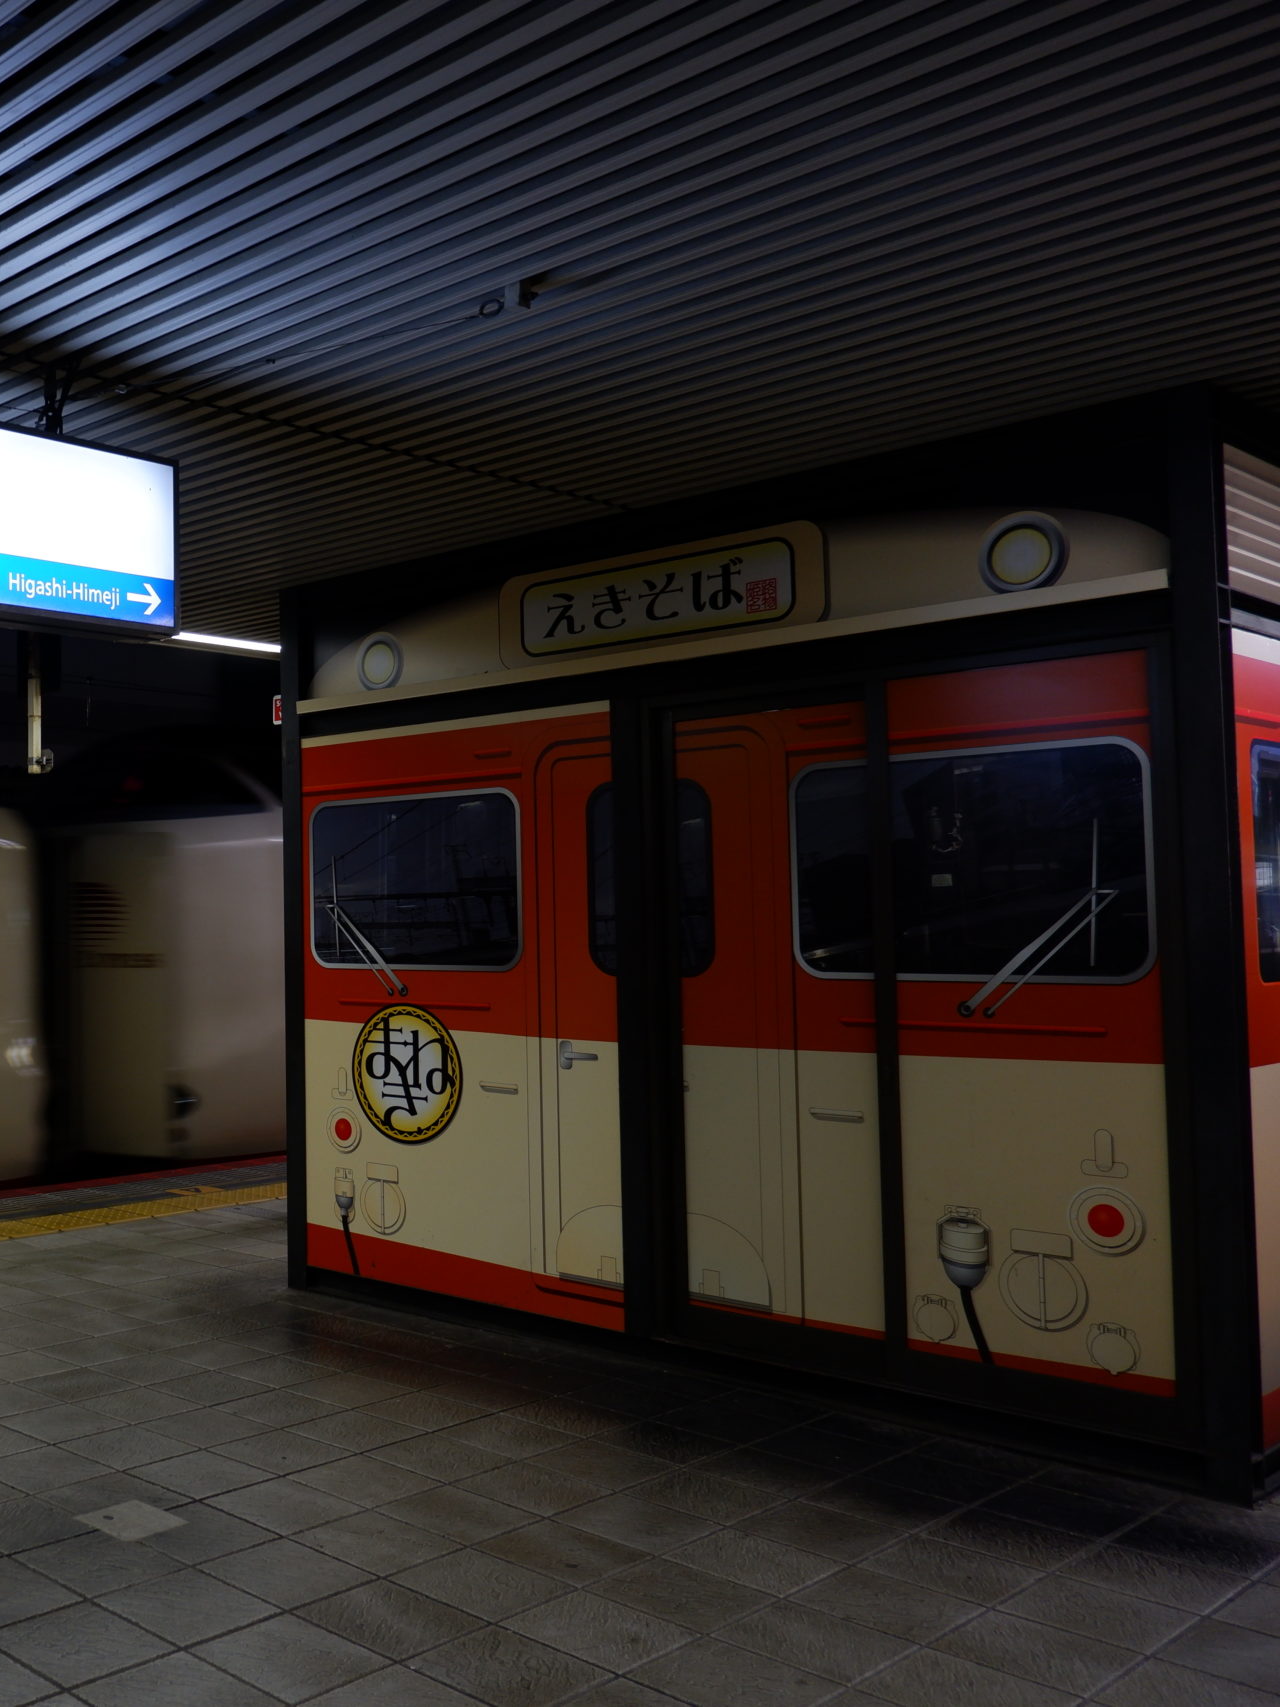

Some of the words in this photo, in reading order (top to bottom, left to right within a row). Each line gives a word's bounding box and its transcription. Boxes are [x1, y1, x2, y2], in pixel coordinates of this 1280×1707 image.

[8, 572, 120, 609] Higashi-Himeji
[545, 557, 743, 637] えきそば
